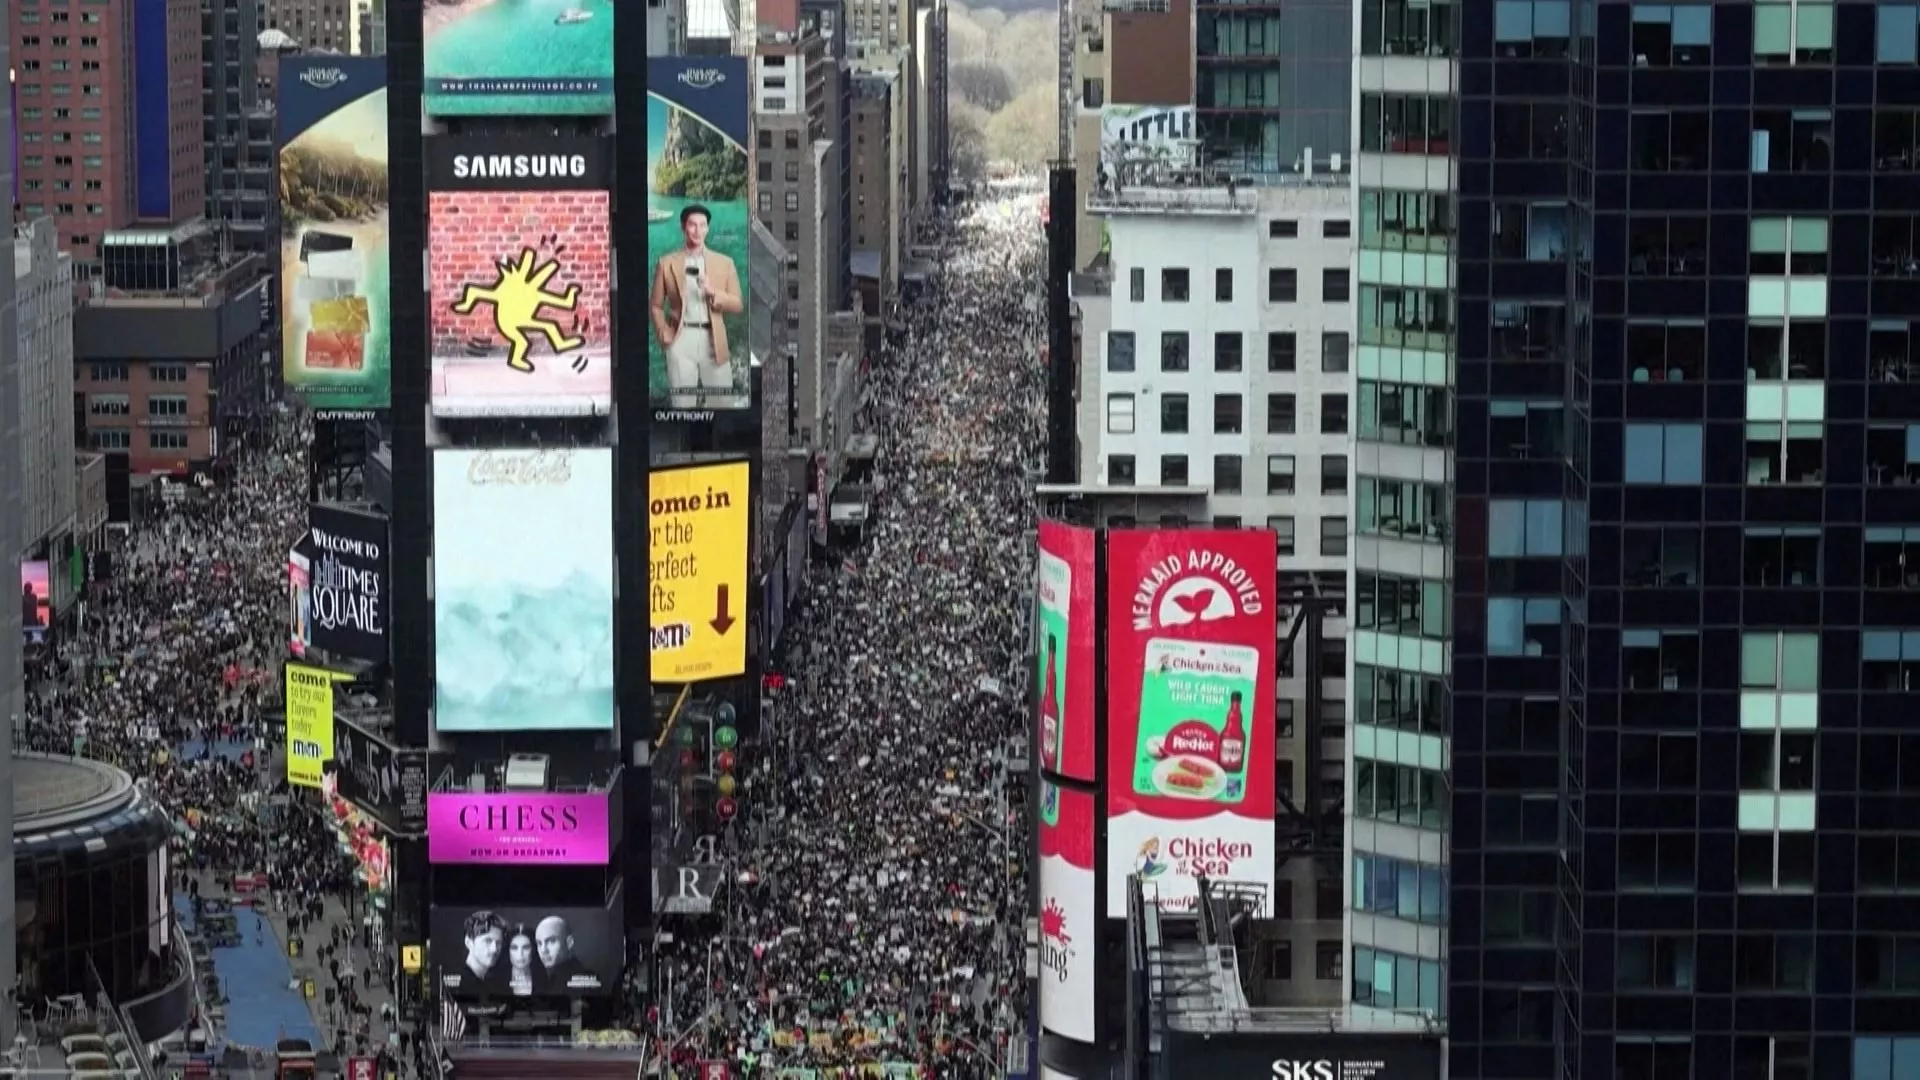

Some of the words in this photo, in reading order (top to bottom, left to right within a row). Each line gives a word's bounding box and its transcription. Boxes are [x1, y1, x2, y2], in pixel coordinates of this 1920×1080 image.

[453, 154, 586, 178] SAMSUNG
[705, 486, 731, 510] in
[665, 516, 693, 545] the
[312, 527, 364, 557] WELCOME
[364, 541, 380, 560] TO
[339, 564, 379, 598] TIMES
[1132, 554, 1183, 632] MERMAID
[1187, 548, 1263, 616] APPROVED
[1172, 656, 1216, 673] Chicken
[1221, 661, 1242, 674] Sea
[290, 670, 327, 689] come
[459, 804, 578, 831] CHESS
[470, 848, 492, 857] NOW
[496, 848, 509, 857] ON
[513, 847, 567, 857] BROADWAY
[1168, 836, 1253, 863] Chicken
[1191, 856, 1229, 878] Sea
[1271, 1059, 1334, 1080] SKS
